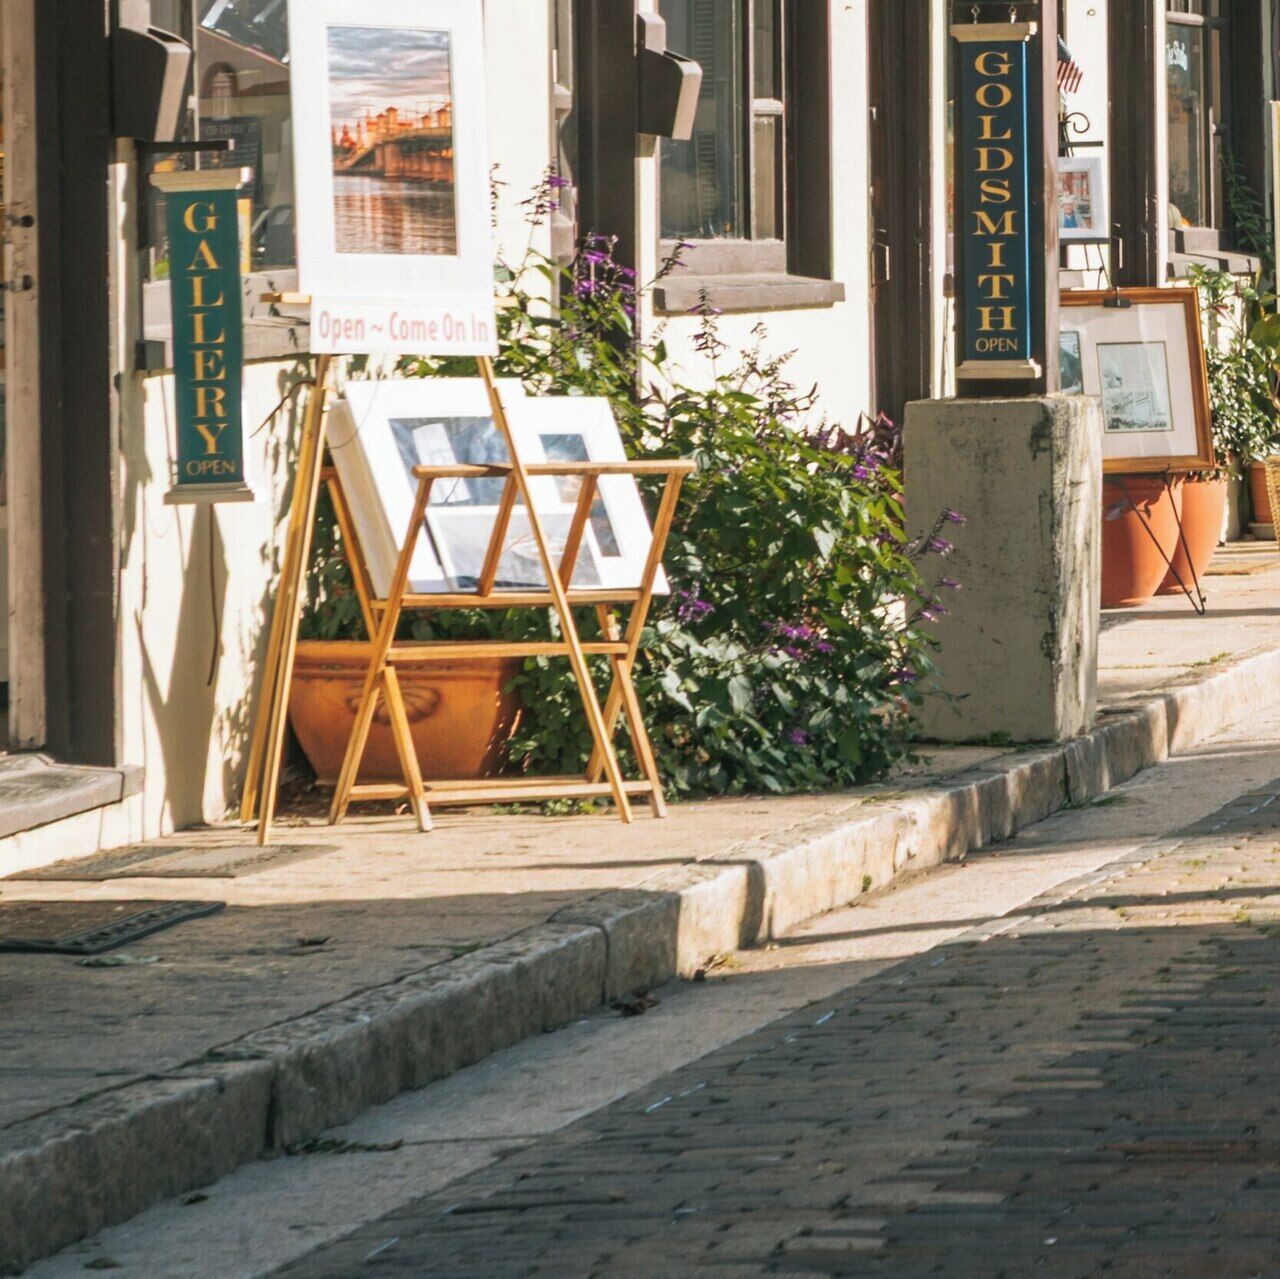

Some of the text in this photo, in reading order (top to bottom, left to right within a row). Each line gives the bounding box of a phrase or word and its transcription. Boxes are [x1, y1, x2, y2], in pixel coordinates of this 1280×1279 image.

[971, 51, 1019, 332] GOLDSMITH
[183, 201, 230, 455] GALLERY
[319, 310, 365, 347] Open
[389, 311, 437, 341] Come
[443, 313, 465, 341] On
[471, 314, 488, 342] In
[975, 337, 1018, 352] OPEN
[186, 459, 236, 477] OPEN
